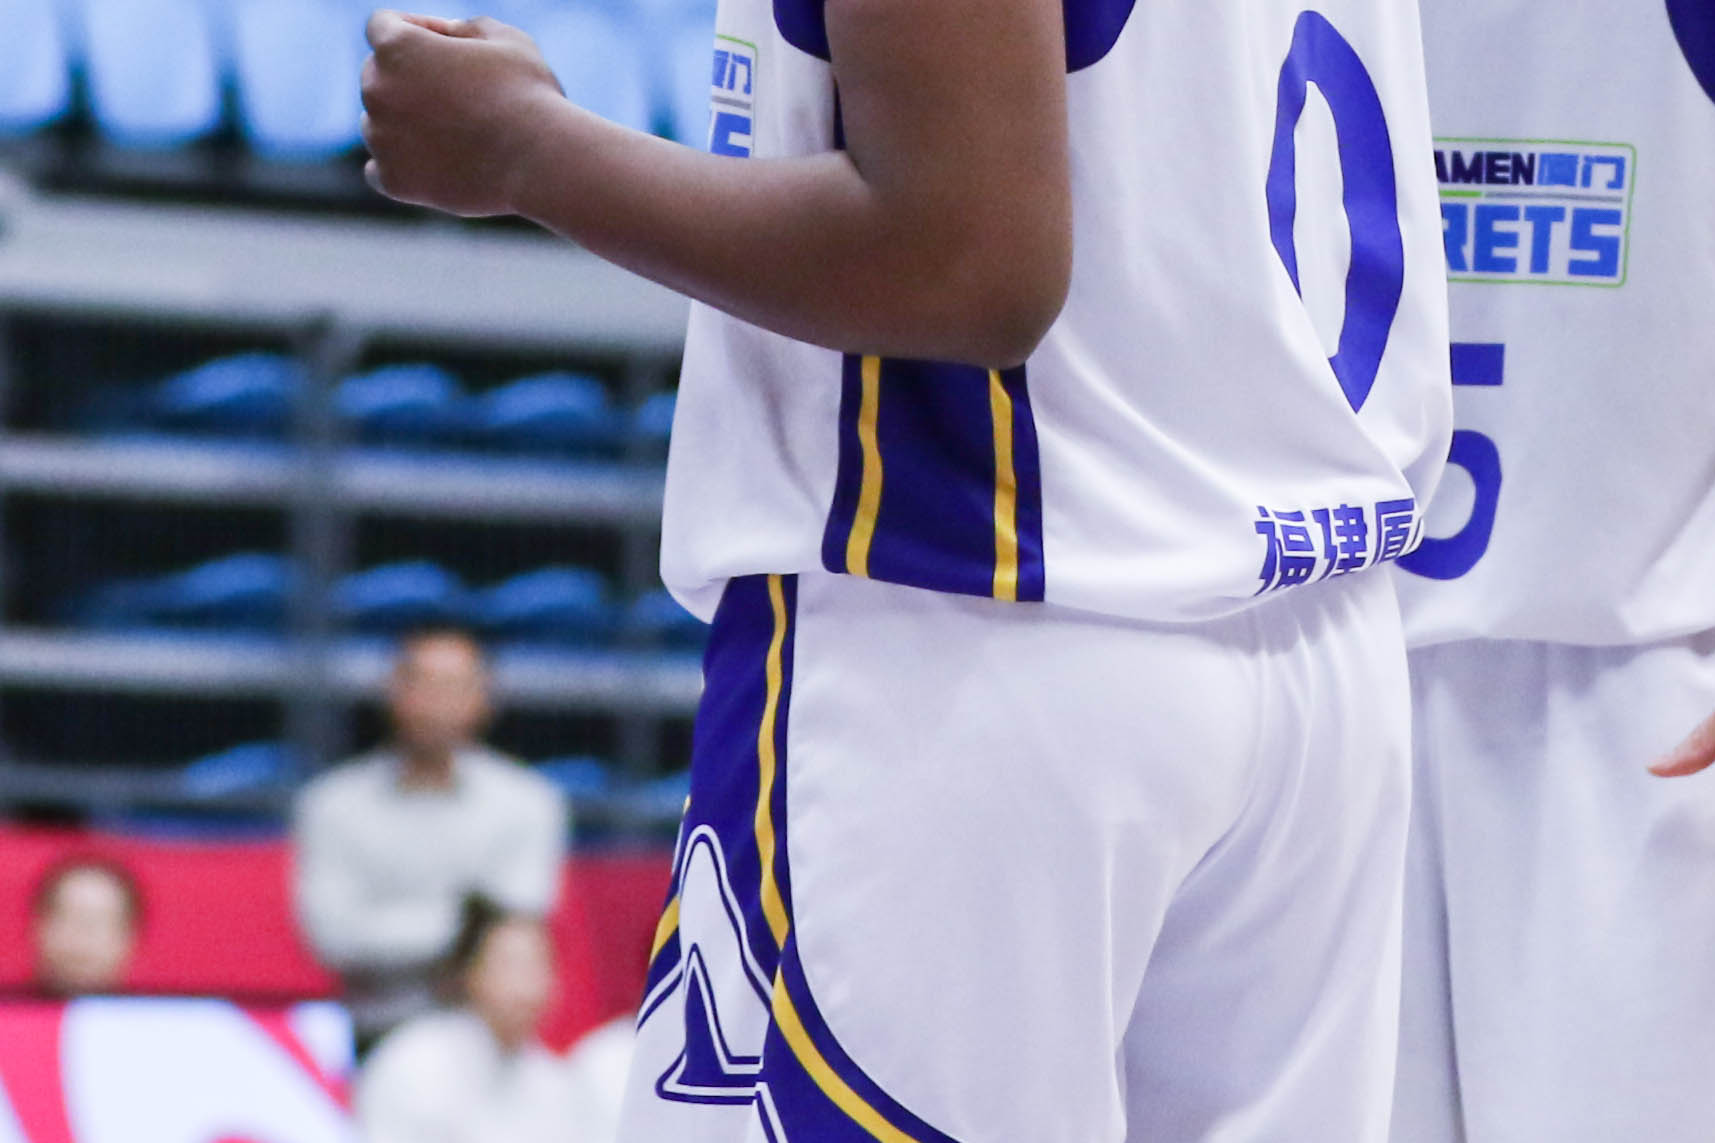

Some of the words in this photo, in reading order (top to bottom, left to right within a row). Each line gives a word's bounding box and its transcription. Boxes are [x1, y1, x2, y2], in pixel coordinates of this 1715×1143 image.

[1266, 10, 1404, 414] 0
[1254, 497, 1424, 597] 福建厦
